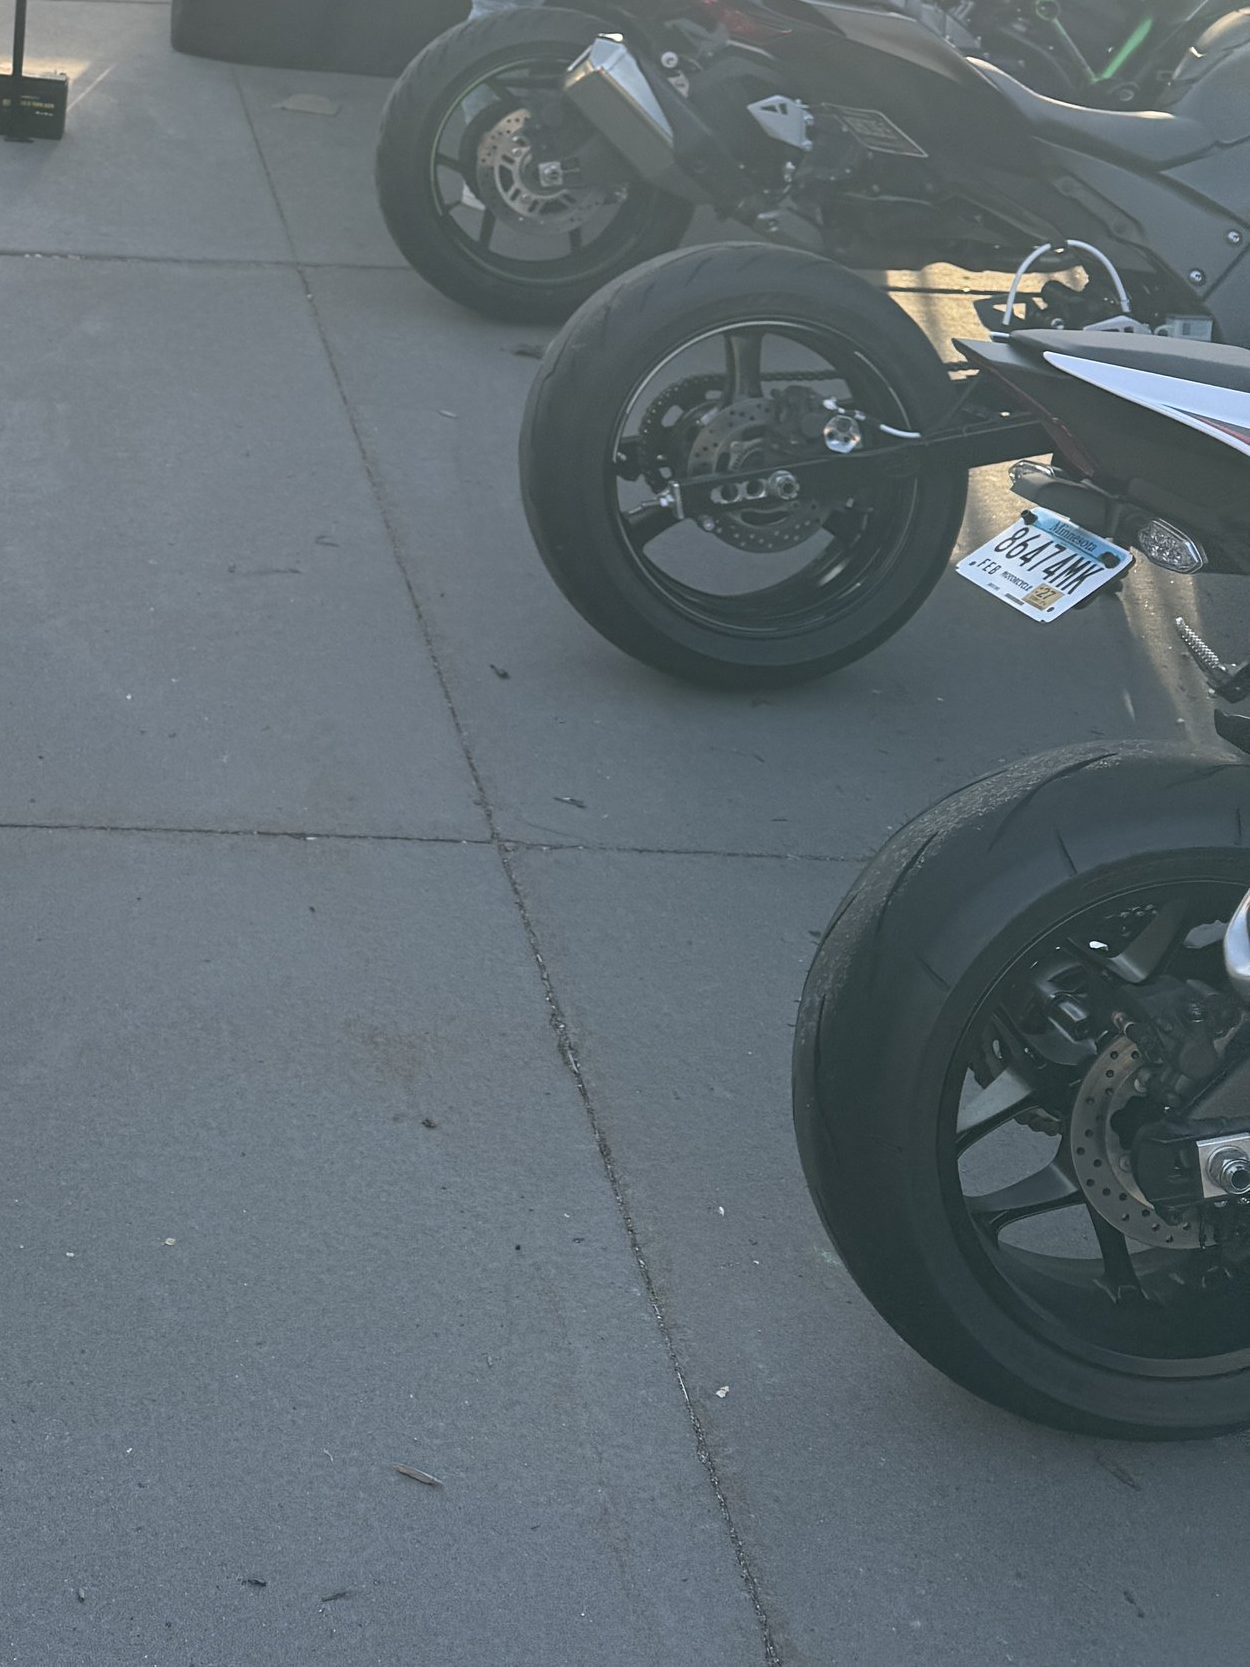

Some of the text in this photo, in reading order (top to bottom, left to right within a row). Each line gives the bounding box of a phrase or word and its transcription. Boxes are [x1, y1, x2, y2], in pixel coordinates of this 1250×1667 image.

[1051, 520, 1098, 553] Minnesota
[977, 557, 1002, 576] FEB
[994, 526, 1104, 595] 86474MK
[1036, 587, 1057, 600] 27
